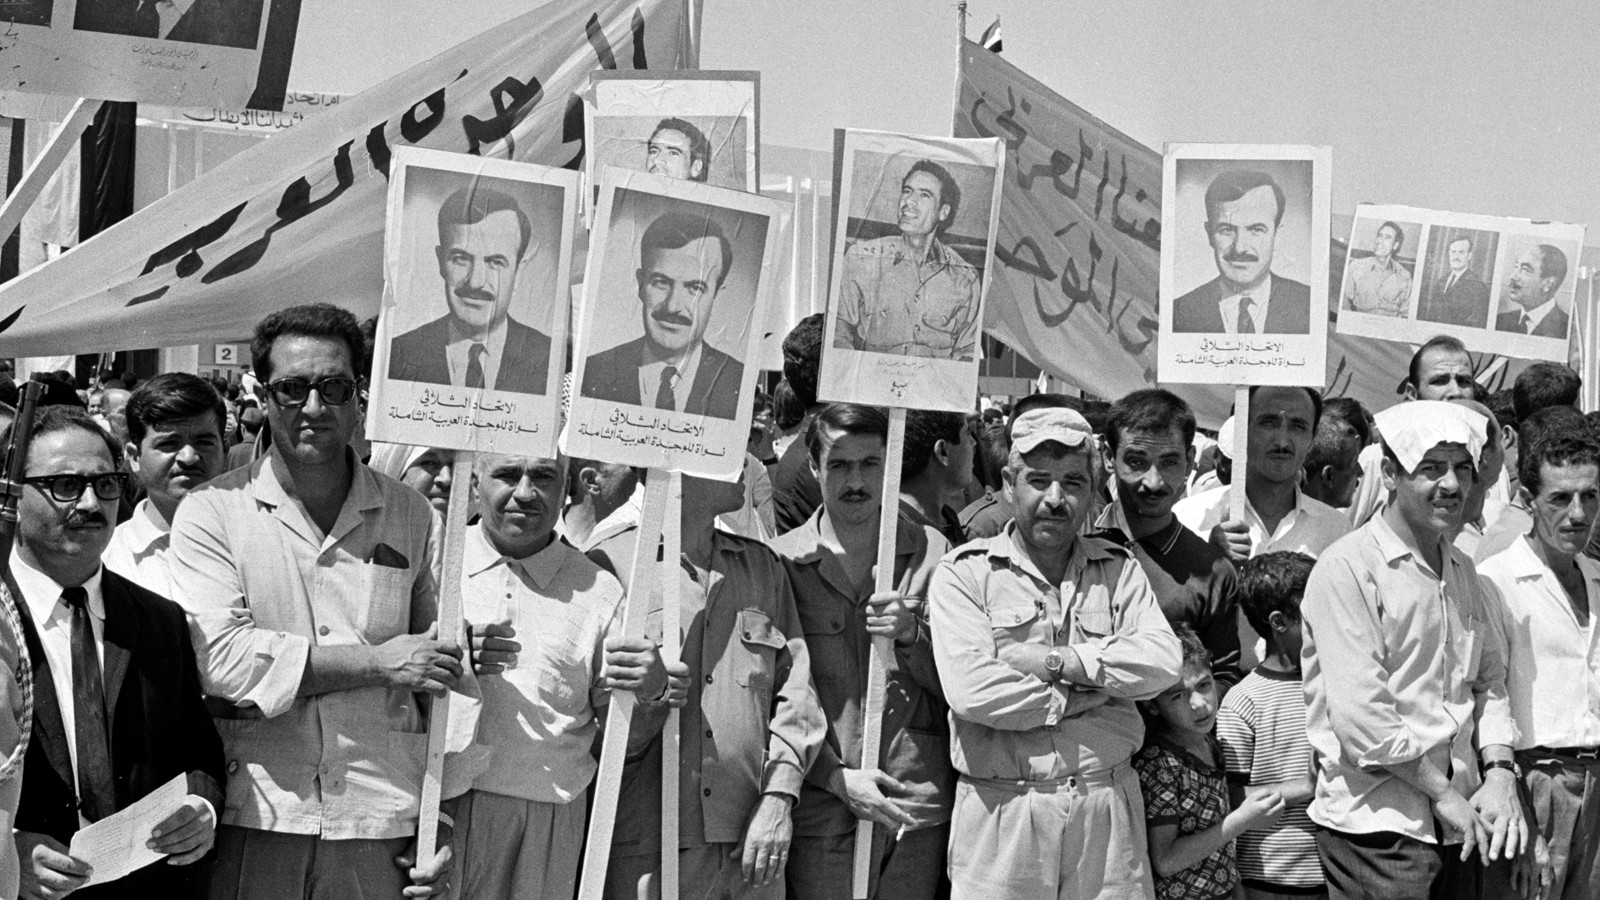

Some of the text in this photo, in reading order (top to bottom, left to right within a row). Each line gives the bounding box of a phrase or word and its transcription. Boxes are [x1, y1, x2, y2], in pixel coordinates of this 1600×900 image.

[287, 91, 325, 106] اتحاد
[221, 347, 232, 361] 2
[1200, 337, 1284, 353] الاتحاد الثلاثي
[1175, 354, 1306, 368] نواة للوحدة العربية الشاملة
[420, 388, 517, 414] الاتحاد الثلاثي
[388, 406, 539, 434] نواة للوحدة العربية الشاملة
[609, 407, 705, 437] الاتحاد الثلاثي
[578, 423, 726, 457] نواة للوحدة العربية الشاملة
